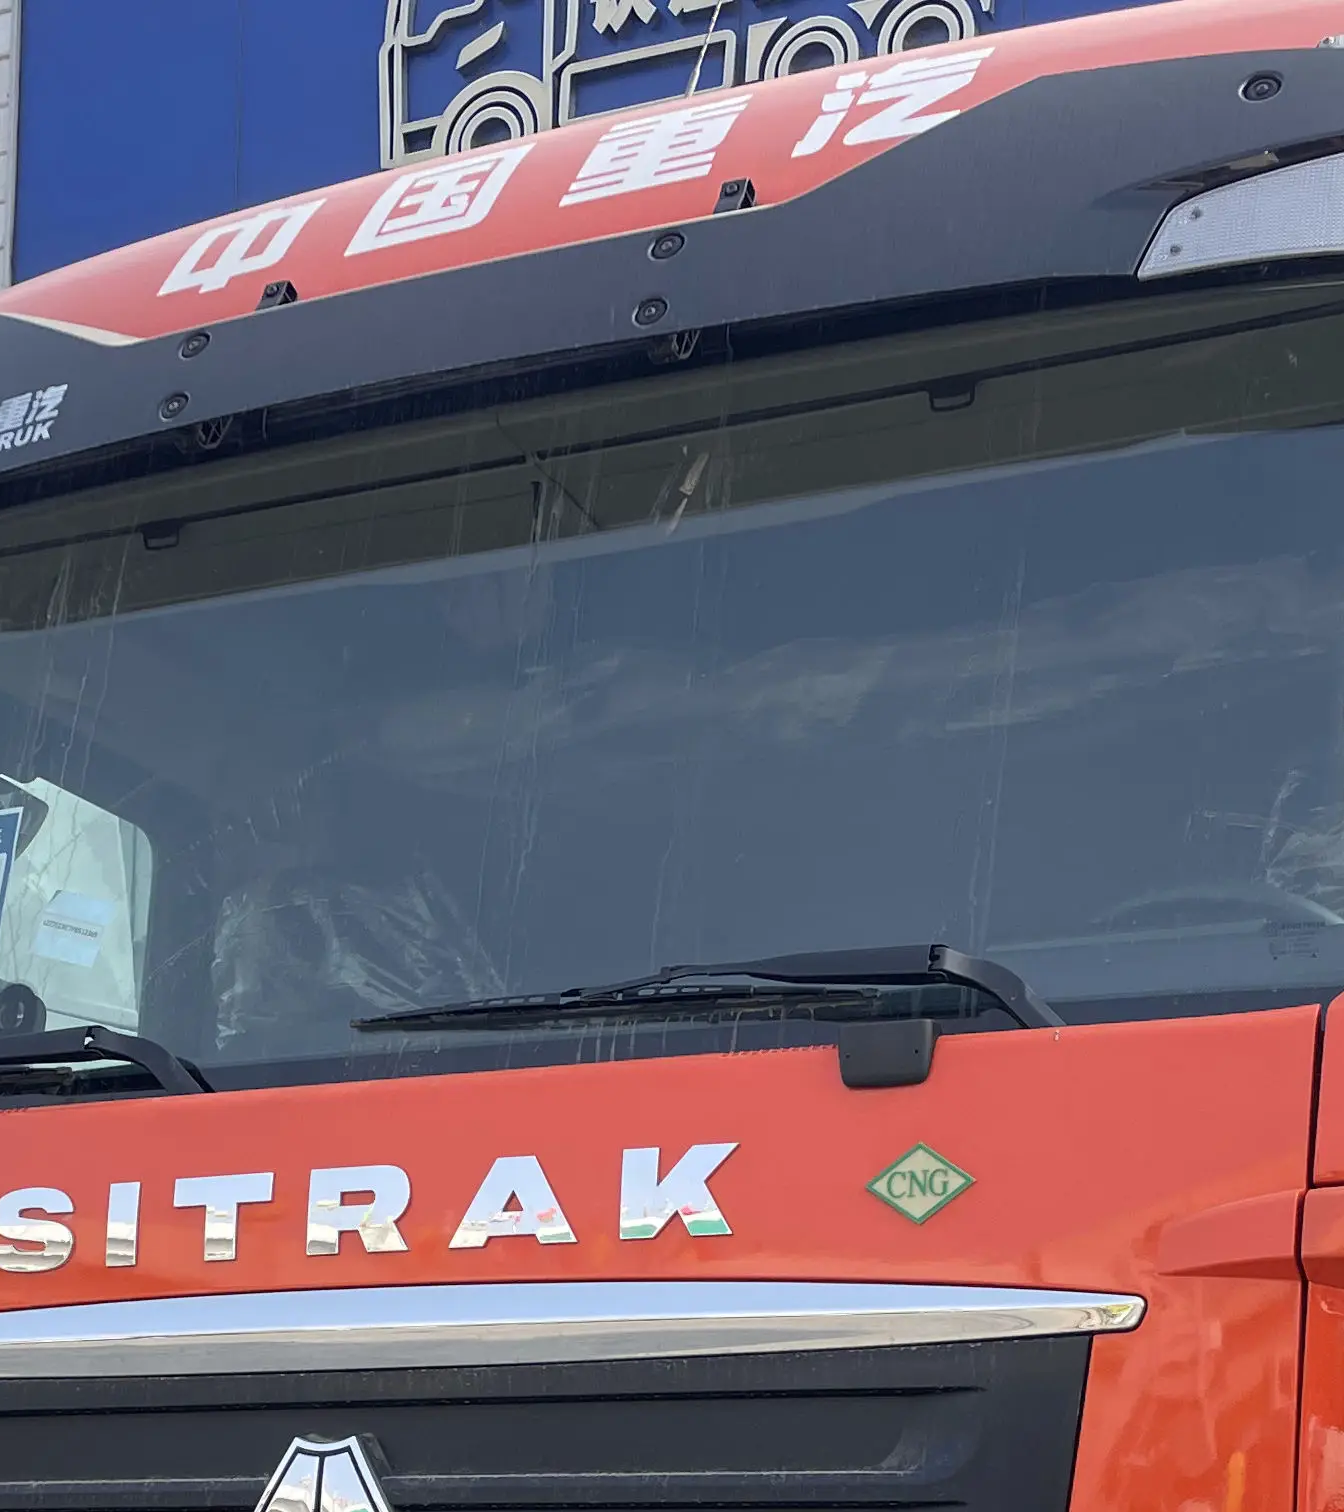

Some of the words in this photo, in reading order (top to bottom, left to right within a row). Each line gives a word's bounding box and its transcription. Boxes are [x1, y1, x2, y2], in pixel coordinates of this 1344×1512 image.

[157, 47, 995, 296] 中国重汽
[887, 1168, 950, 1199] CNG
